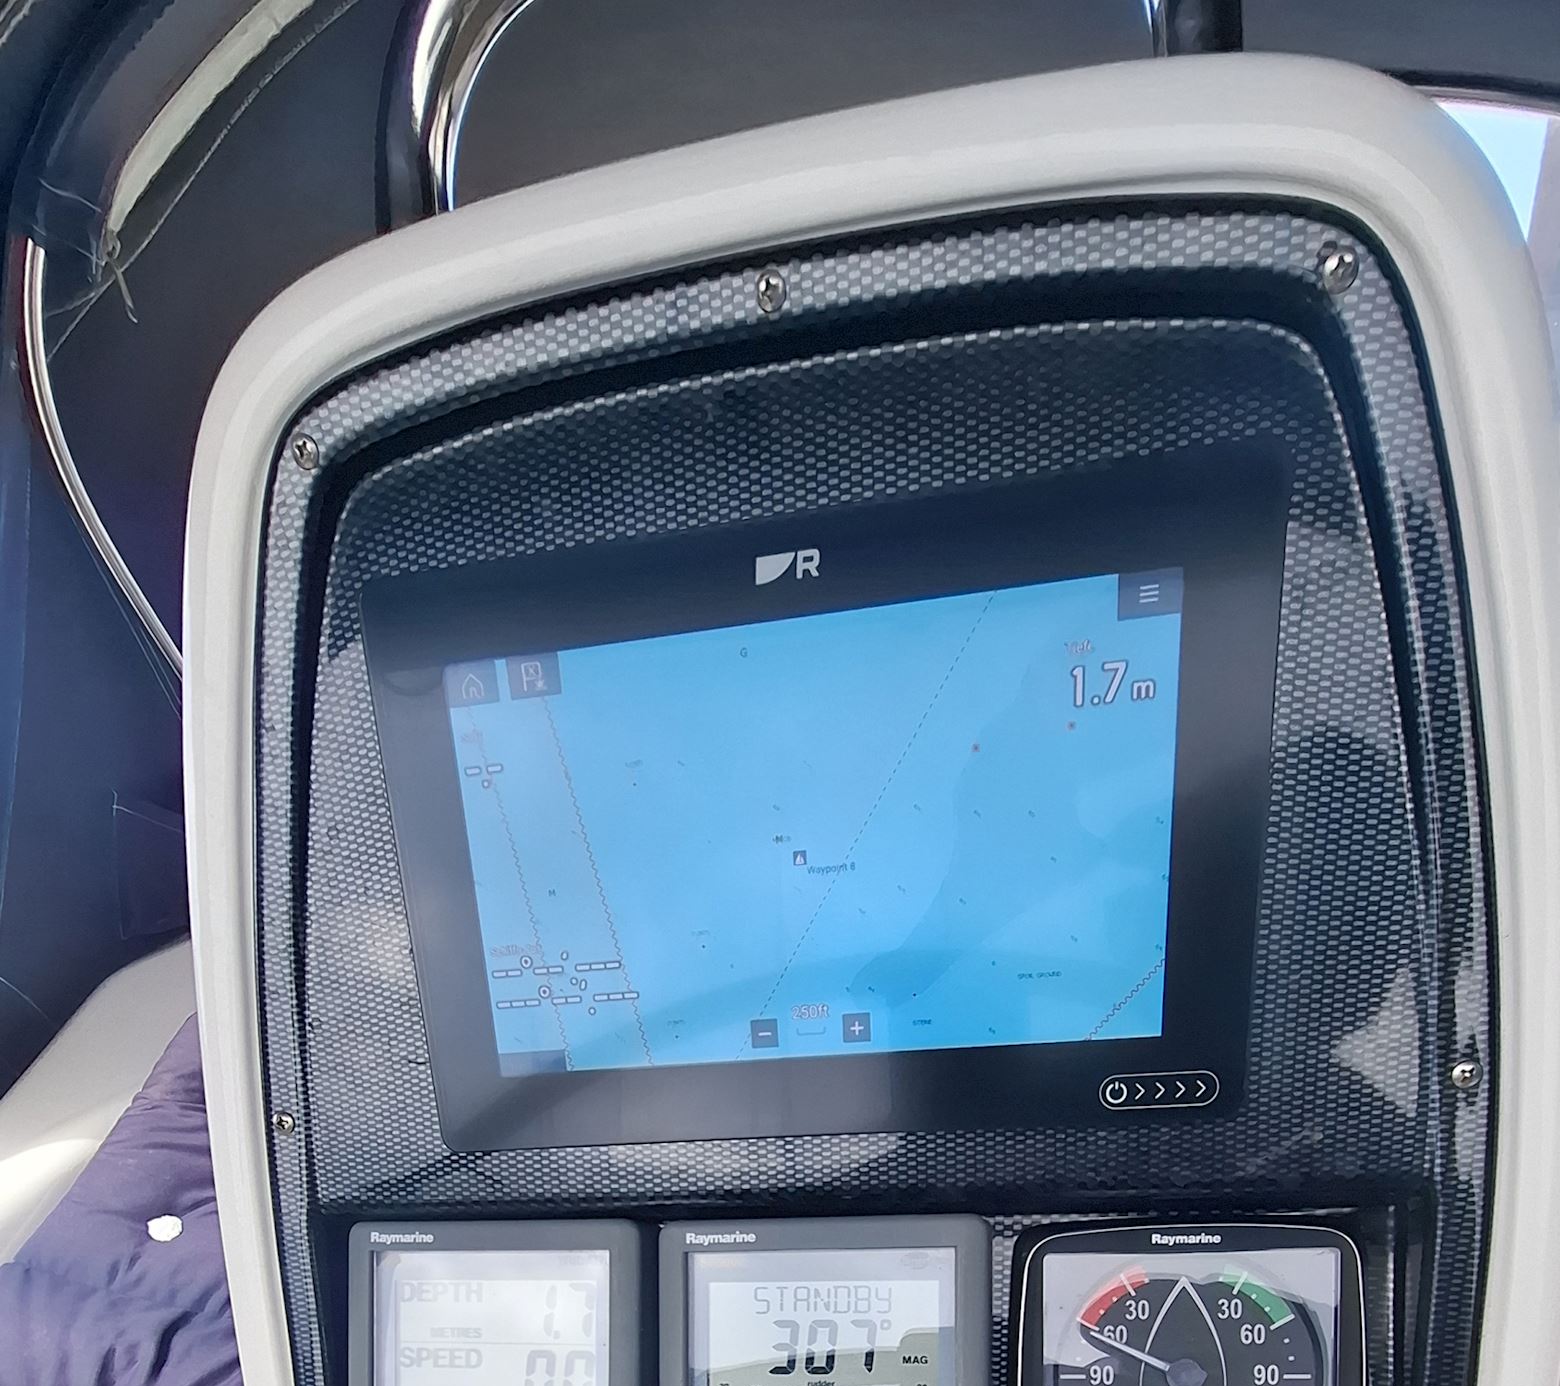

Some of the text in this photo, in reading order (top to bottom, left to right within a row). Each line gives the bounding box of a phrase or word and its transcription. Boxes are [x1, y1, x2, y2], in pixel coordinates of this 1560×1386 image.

[1071, 659, 1156, 708] 1.7 m
[792, 1004, 829, 1020] 250ft
[370, 1231, 434, 1245] Raymarine
[685, 1230, 757, 1246] Raymarine
[1151, 1232, 1222, 1245] Raymarine
[401, 1282, 484, 1304] DEPTH
[754, 1286, 893, 1315] STANDBY
[1124, 1299, 1150, 1321] 30
[1217, 1299, 1243, 1321] 30
[1102, 1324, 1128, 1345] 60
[1239, 1323, 1266, 1345] 60
[400, 1348, 484, 1370] SPEED
[902, 1356, 929, 1365] MAG
[1089, 1363, 1114, 1386] 90
[1253, 1363, 1280, 1386] 90
